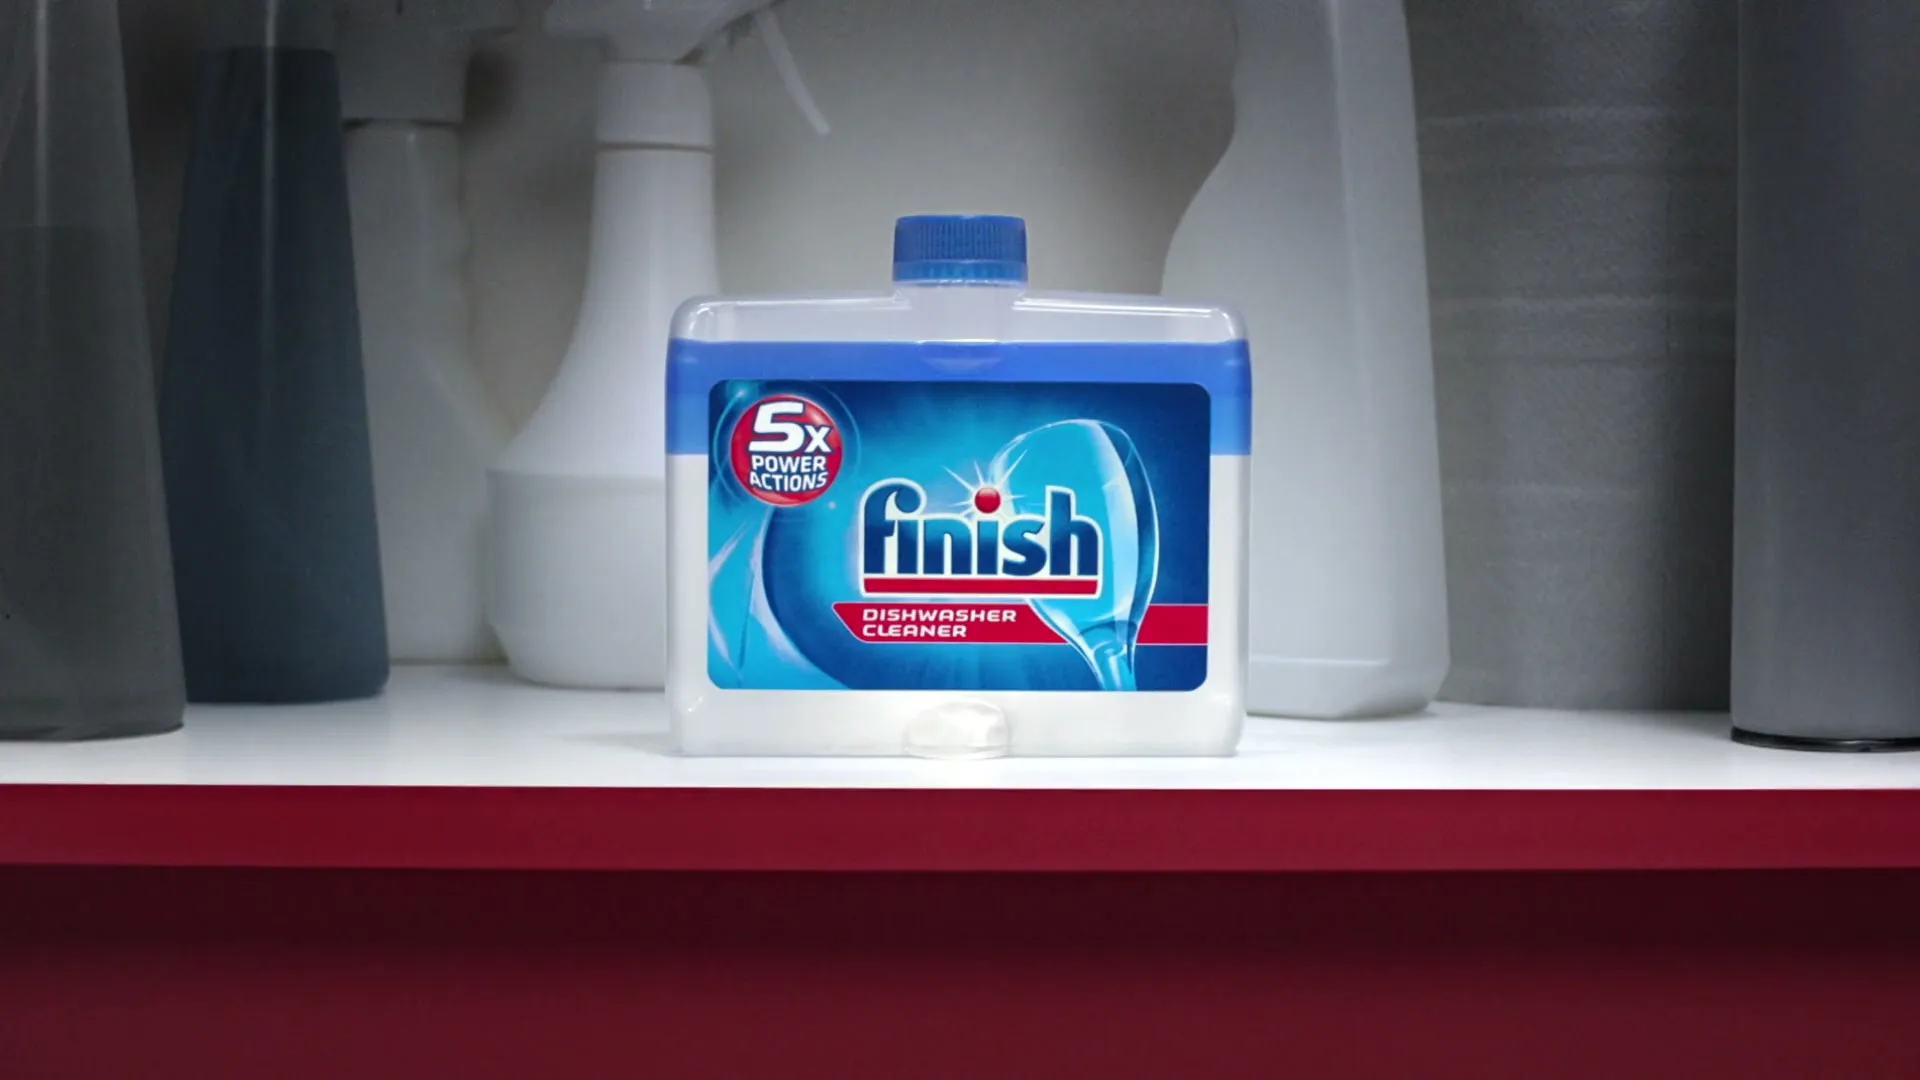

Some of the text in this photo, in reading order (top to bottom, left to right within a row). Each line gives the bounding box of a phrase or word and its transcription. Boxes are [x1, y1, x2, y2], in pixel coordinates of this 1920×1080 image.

[751, 455, 826, 473] POWER
[750, 471, 829, 492] ACTIONS
[862, 481, 1100, 577] finish
[863, 608, 1017, 622] DISHWASHER
[863, 624, 967, 637] CLEANER
